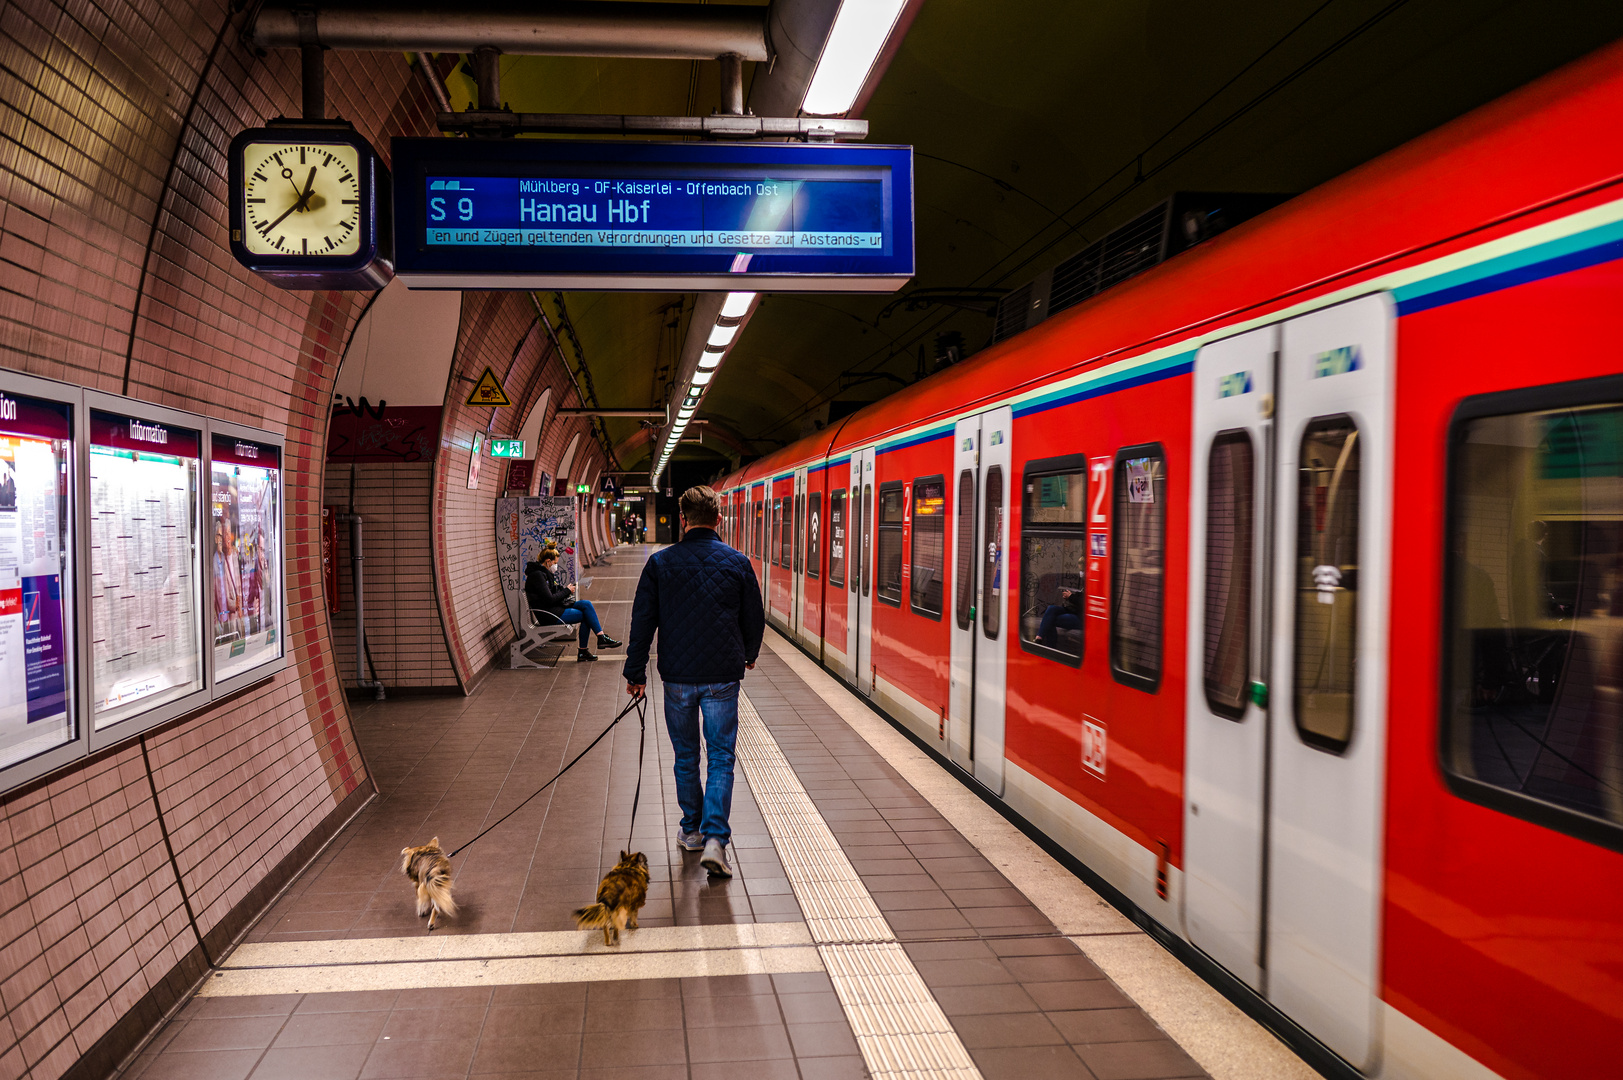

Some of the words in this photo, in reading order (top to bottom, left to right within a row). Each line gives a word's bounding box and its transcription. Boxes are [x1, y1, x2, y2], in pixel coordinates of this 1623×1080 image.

[520, 180, 579, 194] Mühlberg
[594, 182, 672, 194] OF-Kaiserlei
[686, 182, 752, 196] Offenbach
[756, 183, 778, 196] Ost
[430, 198, 446, 221] S
[458, 198, 474, 221] 9
[520, 198, 597, 222] Hanau
[608, 199, 650, 223] Hbf
[456, 230, 479, 242] und
[484, 230, 523, 246] Zügen
[528, 231, 593, 246] geltenden
[598, 231, 686, 247] Verordnungen
[690, 232, 714, 244] und
[718, 232, 770, 245] Gesetze
[775, 235, 794, 245] zur
[800, 234, 866, 246] Abstands-
[130, 419, 168, 444] Information
[604, 478, 614, 488] A
[1091, 462, 1107, 523] 2
[904, 486, 910, 522] 2
